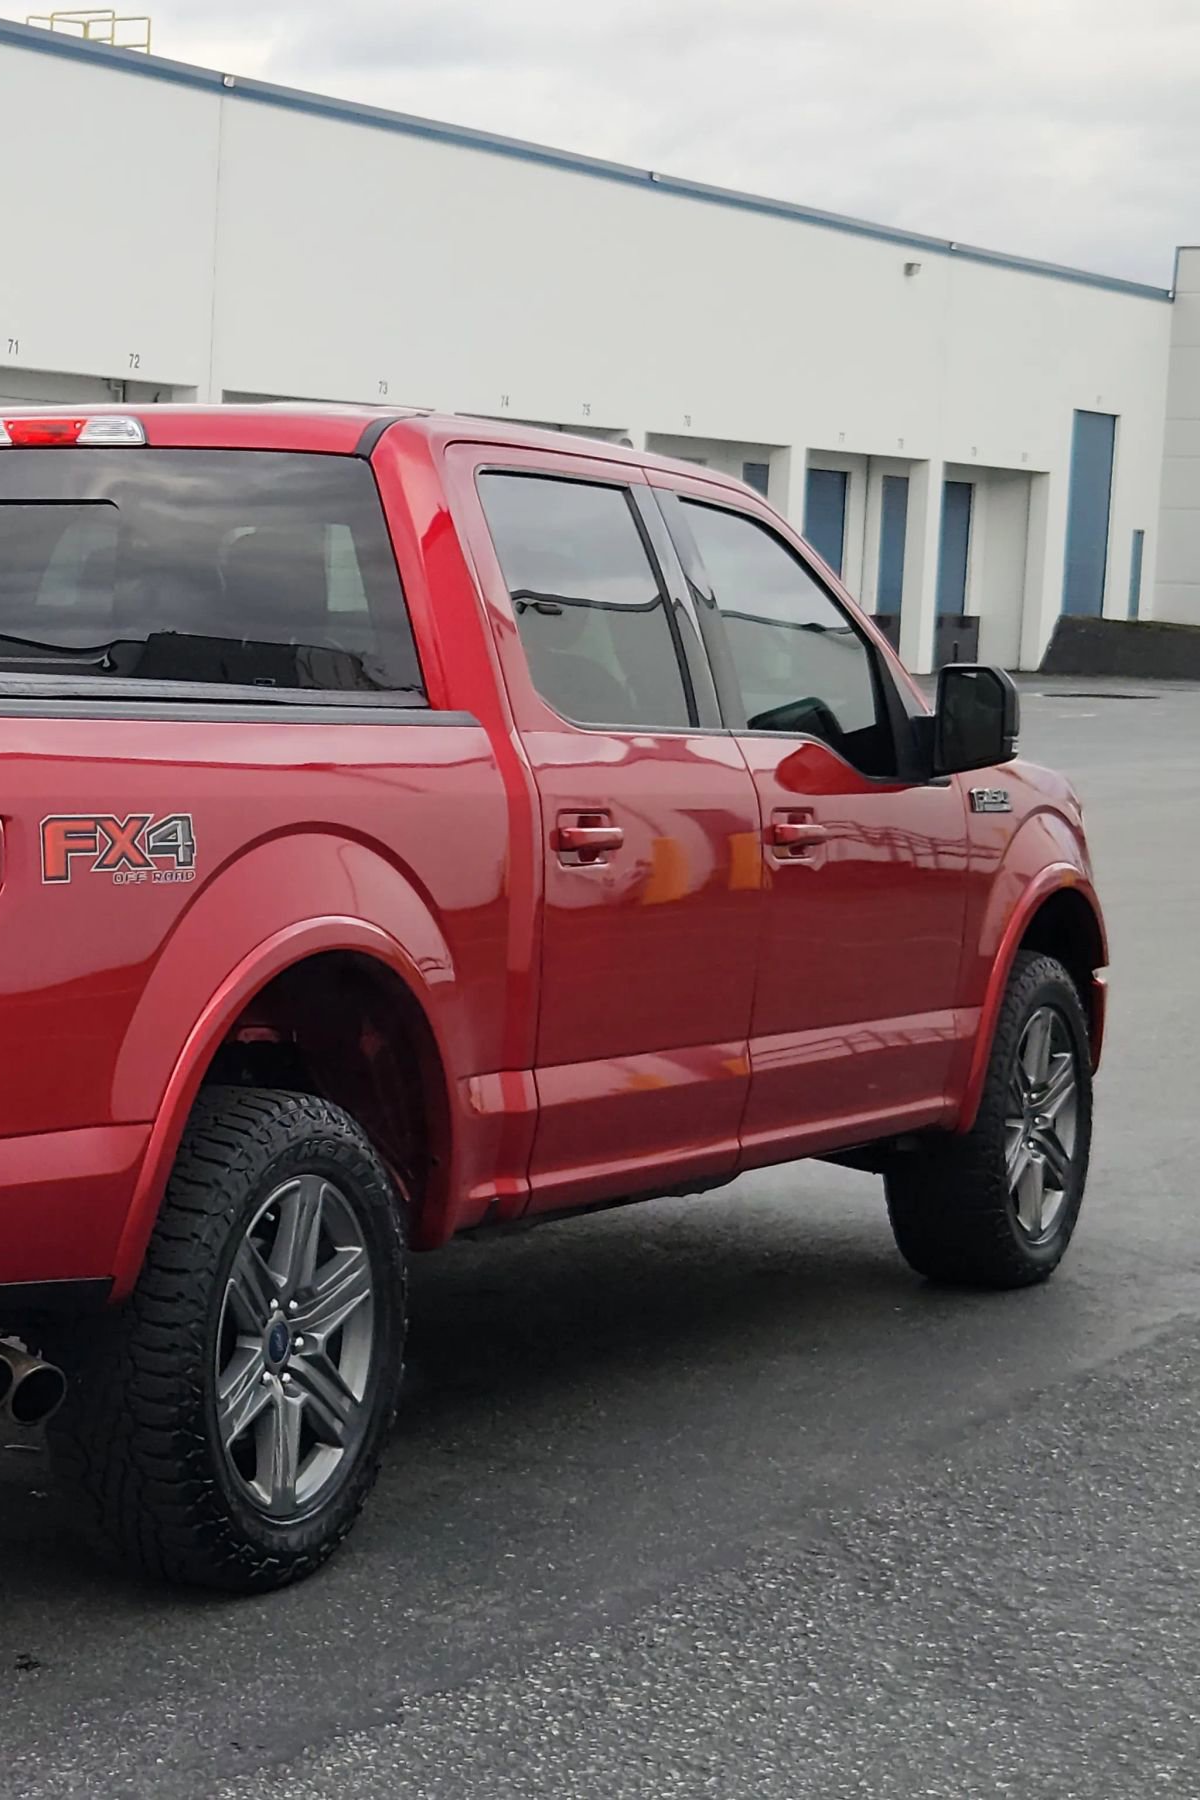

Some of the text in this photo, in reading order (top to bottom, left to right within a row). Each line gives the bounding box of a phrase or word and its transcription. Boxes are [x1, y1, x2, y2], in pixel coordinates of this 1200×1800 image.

[7, 338, 19, 356] 71
[128, 352, 141, 369] 72
[378, 380, 388, 395] 73
[39, 813, 197, 884] FX4
[112, 870, 196, 885] OFF ROAD
